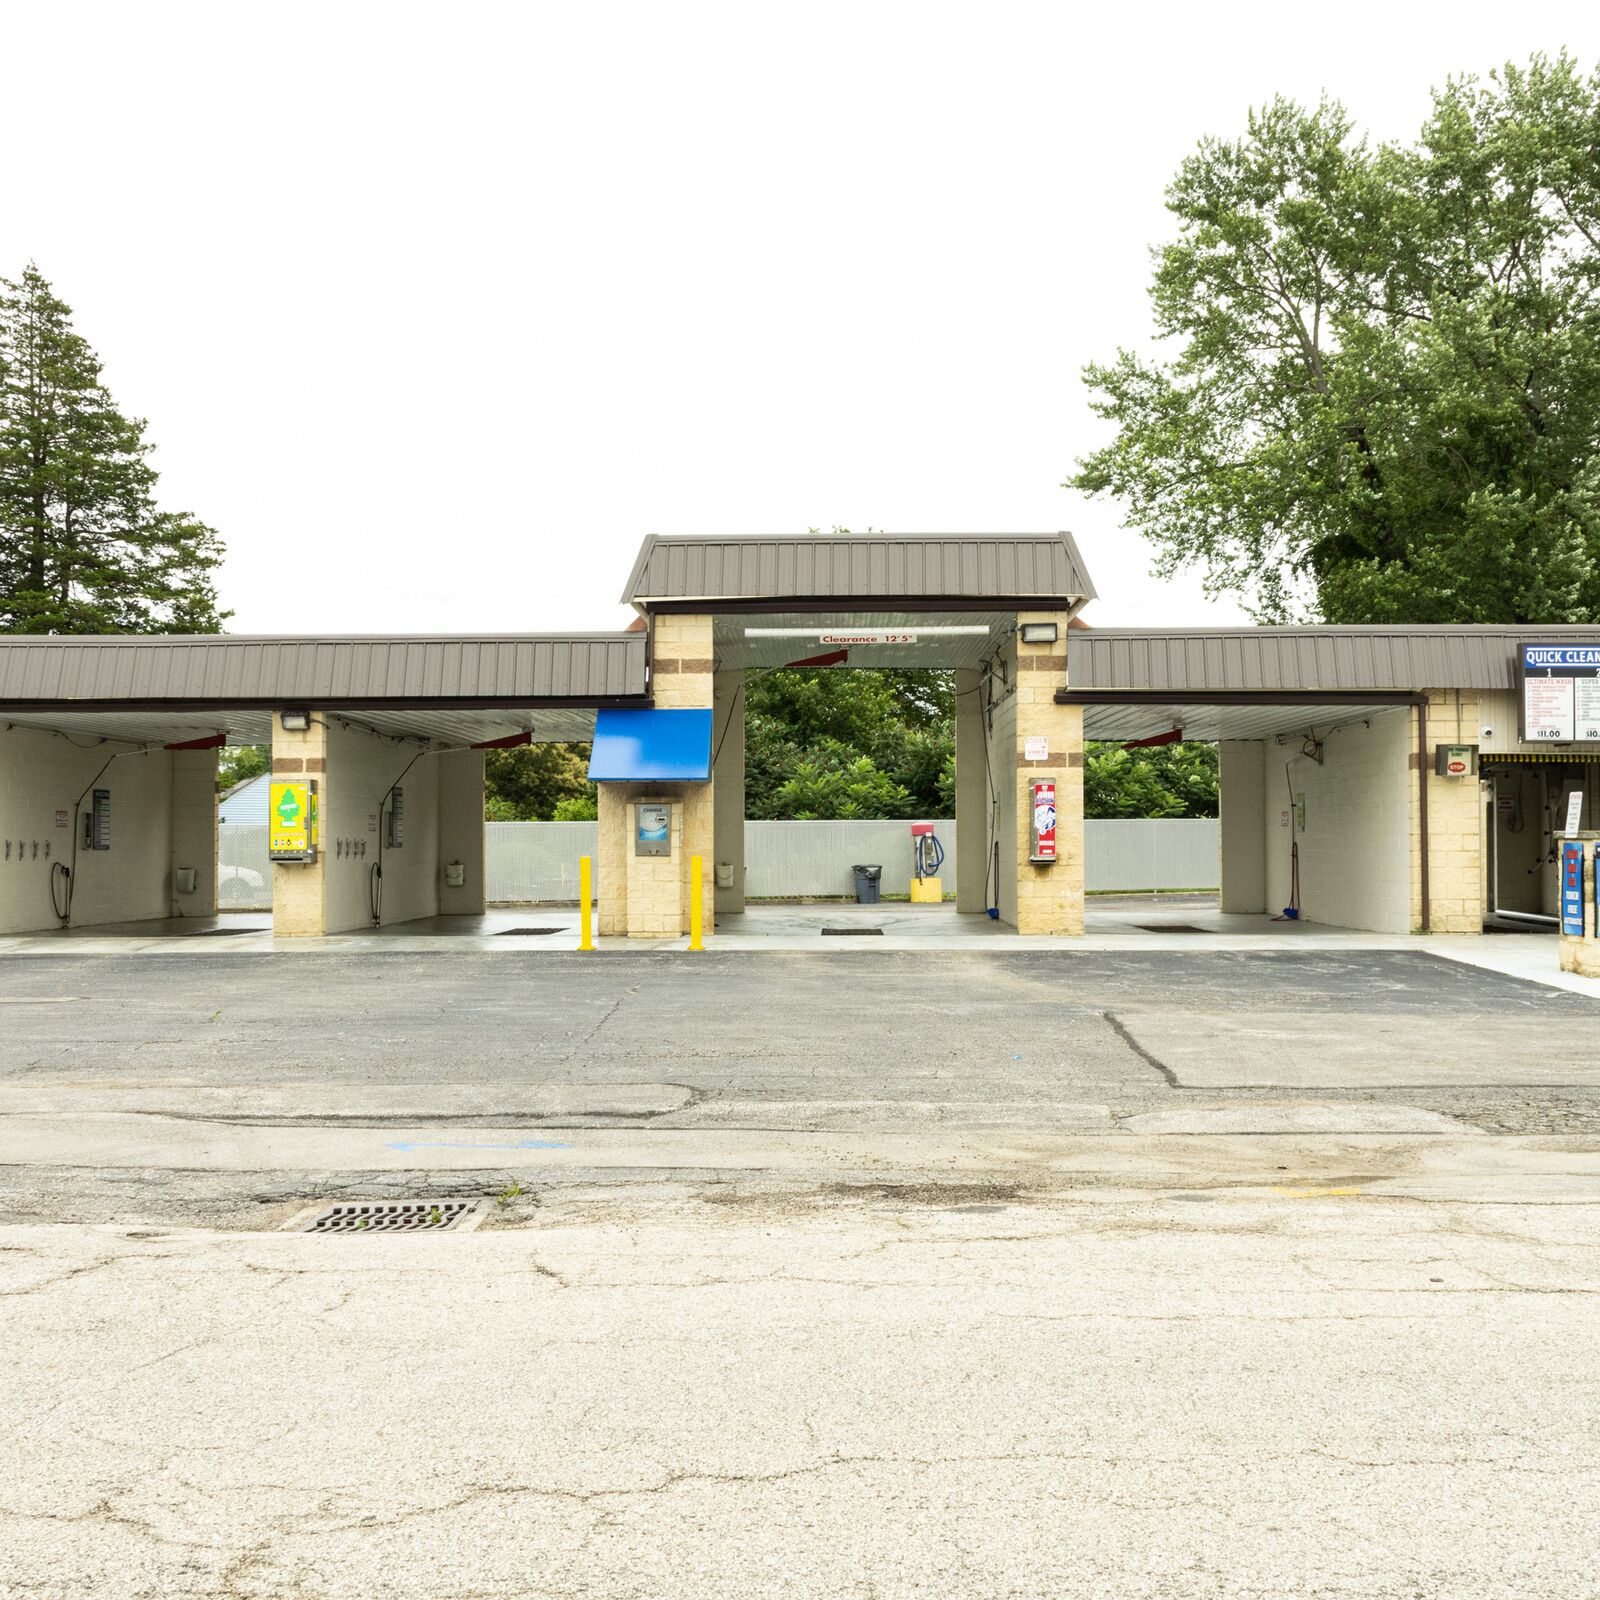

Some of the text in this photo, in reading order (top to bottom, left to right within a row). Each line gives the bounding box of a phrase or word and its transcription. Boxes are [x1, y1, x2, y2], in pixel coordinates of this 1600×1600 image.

[1526, 651, 1563, 664] QUICK
[1546, 668, 1552, 678] 1
[1537, 730, 1561, 738] $11.00
